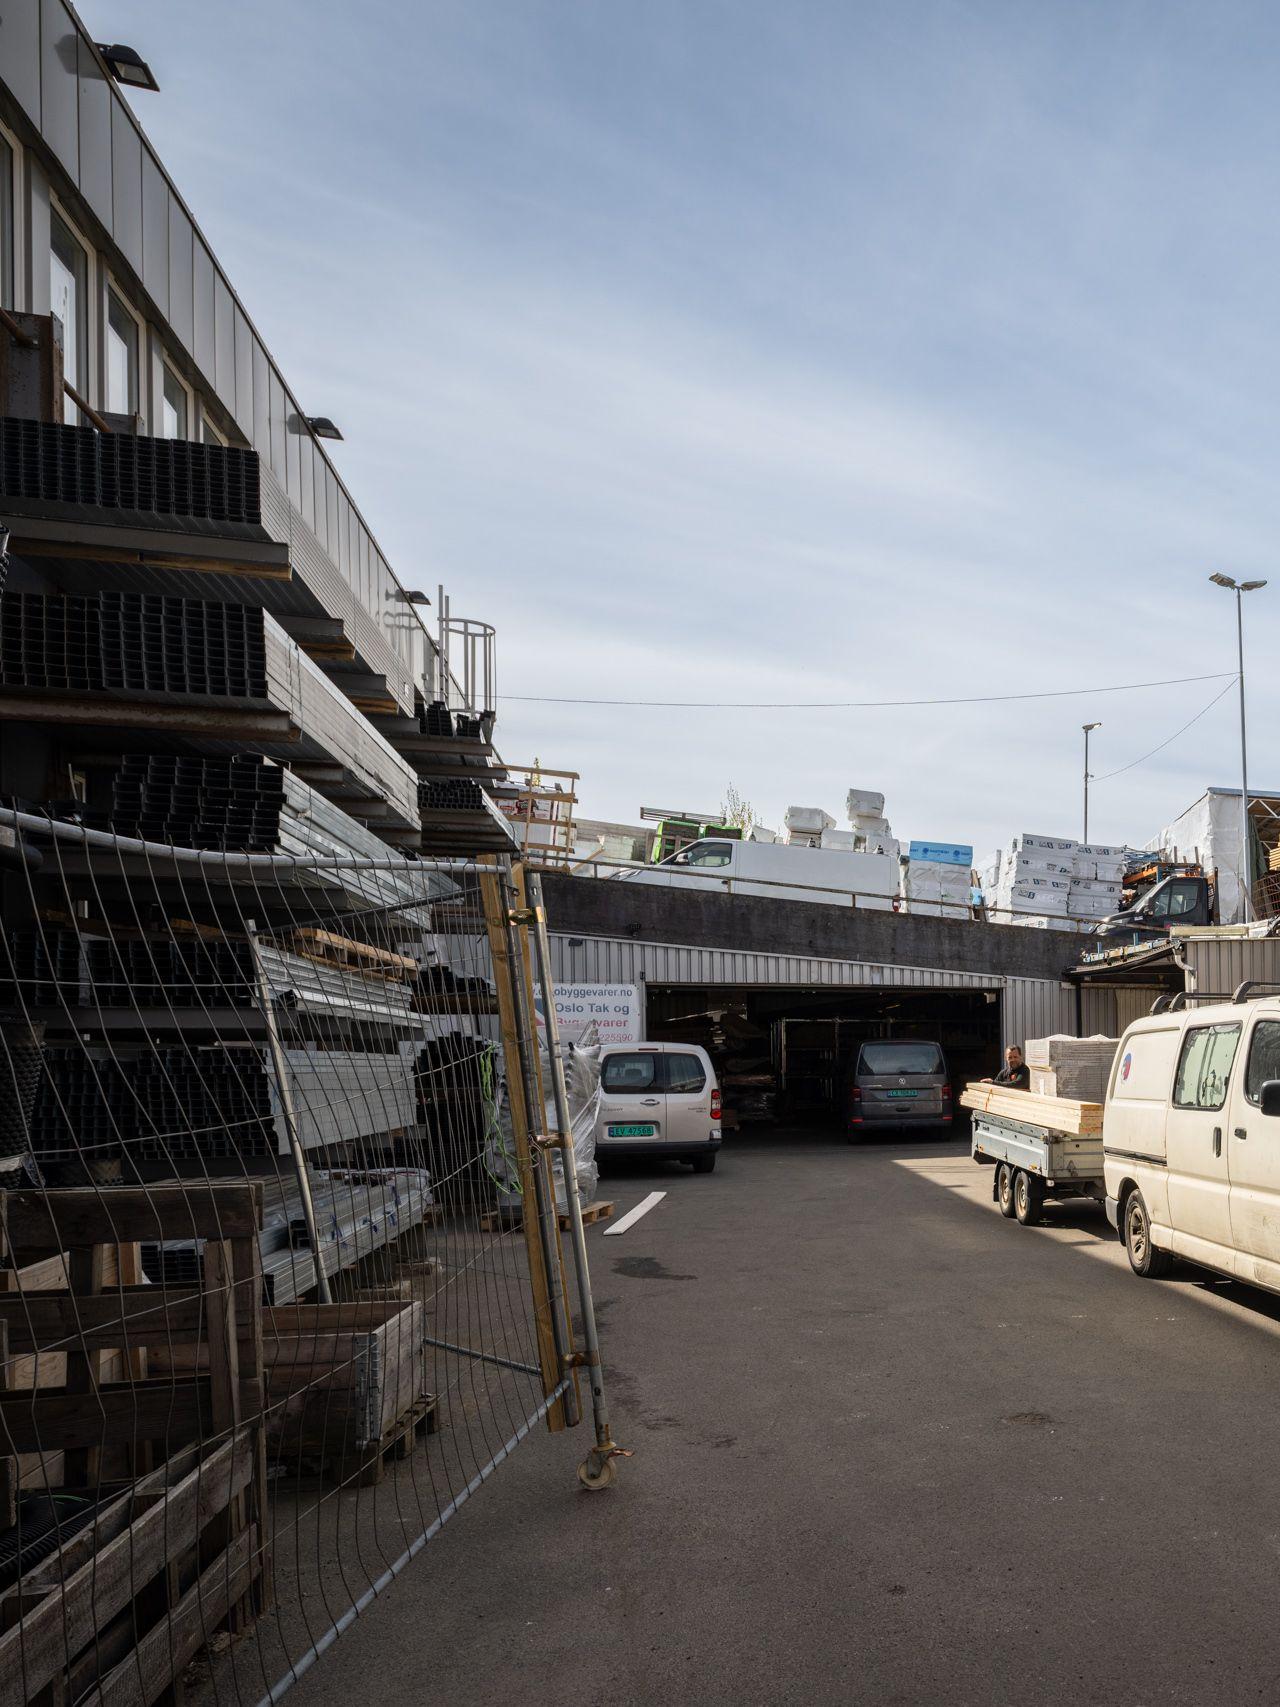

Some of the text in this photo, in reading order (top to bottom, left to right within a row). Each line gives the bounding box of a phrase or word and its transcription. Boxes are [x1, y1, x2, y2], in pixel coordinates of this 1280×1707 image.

[555, 1003, 630, 1015] Oslo Tak og
